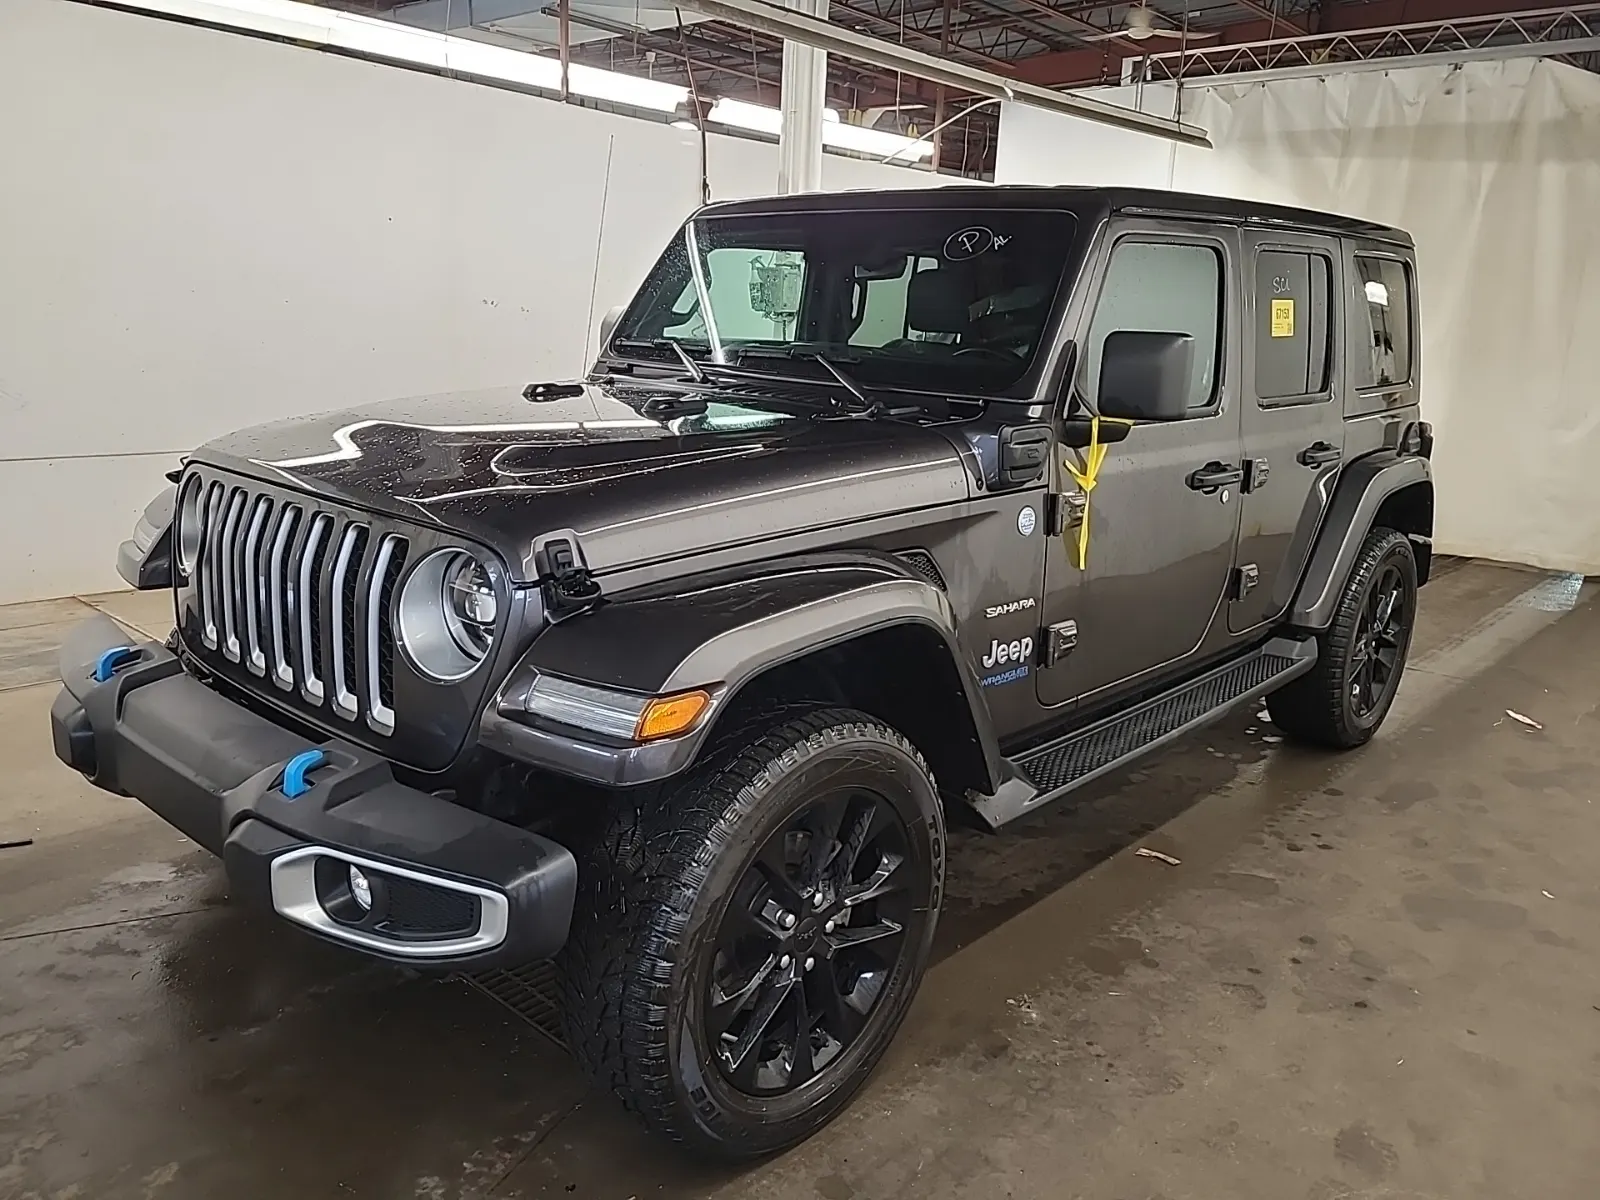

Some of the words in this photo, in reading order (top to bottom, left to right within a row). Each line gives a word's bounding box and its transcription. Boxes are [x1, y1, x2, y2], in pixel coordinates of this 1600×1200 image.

[958, 231, 980, 253] P
[985, 598, 1036, 618] SAHARA
[982, 636, 1034, 669] Jeep
[928, 813, 942, 911] TOYO
